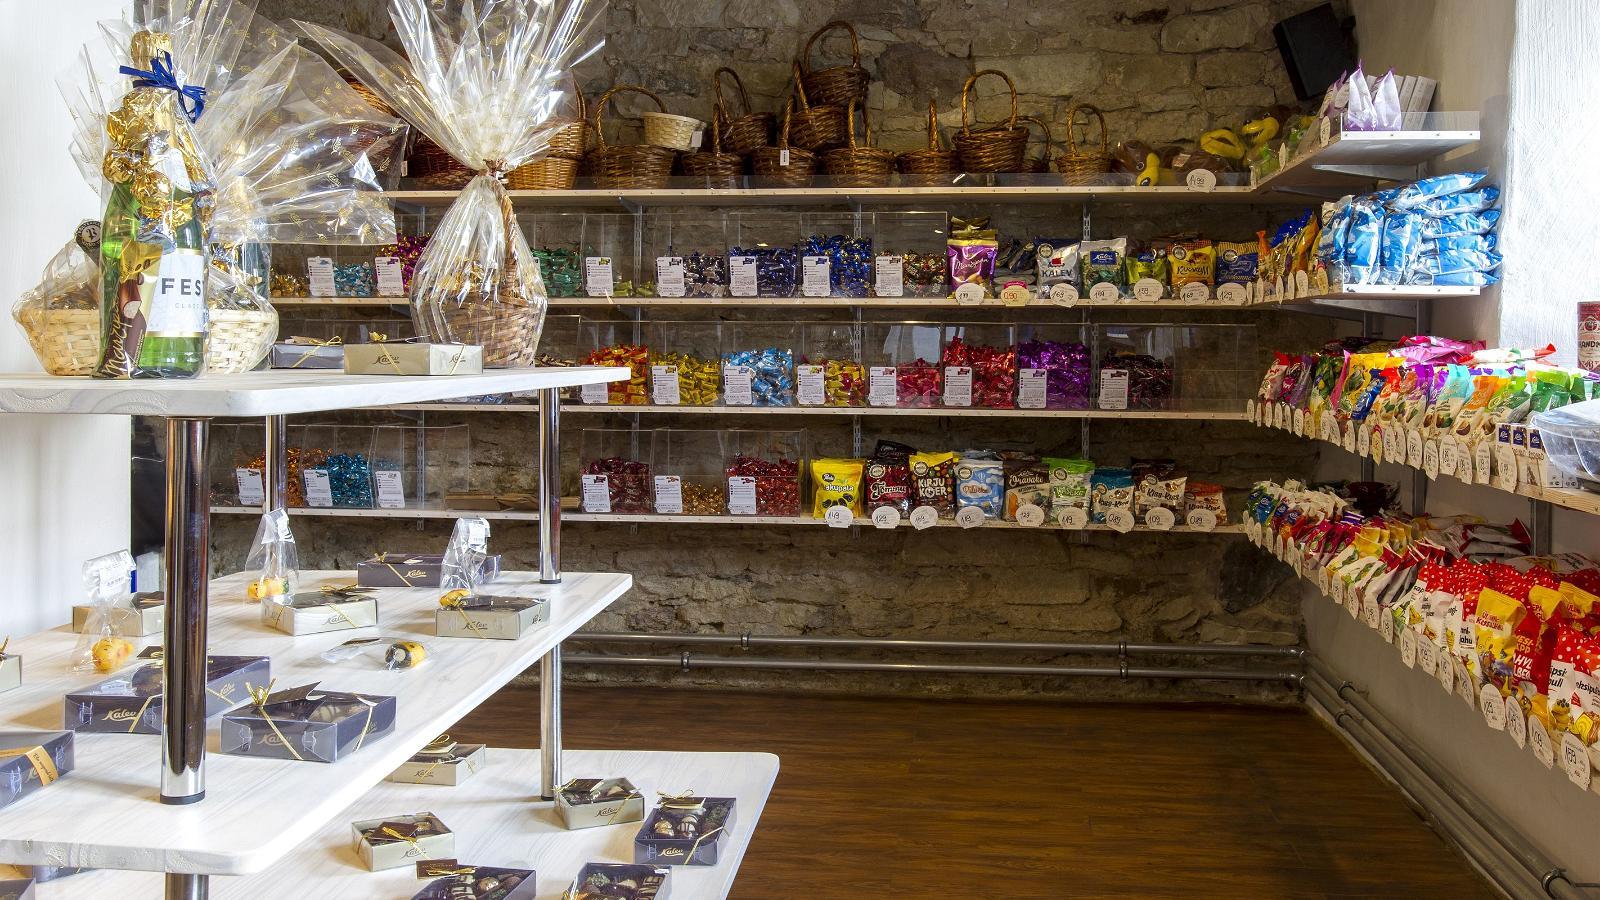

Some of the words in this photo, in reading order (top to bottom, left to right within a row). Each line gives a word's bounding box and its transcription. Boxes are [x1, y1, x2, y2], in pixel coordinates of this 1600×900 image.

[1041, 269, 1072, 278] KALEV
[918, 477, 945, 488] KIRJU
[919, 486, 947, 498] KOER
[404, 569, 427, 578] Kalev
[101, 709, 138, 721] Kalev
[595, 807, 618, 817] Kalev
[658, 848, 684, 857] Kalev
